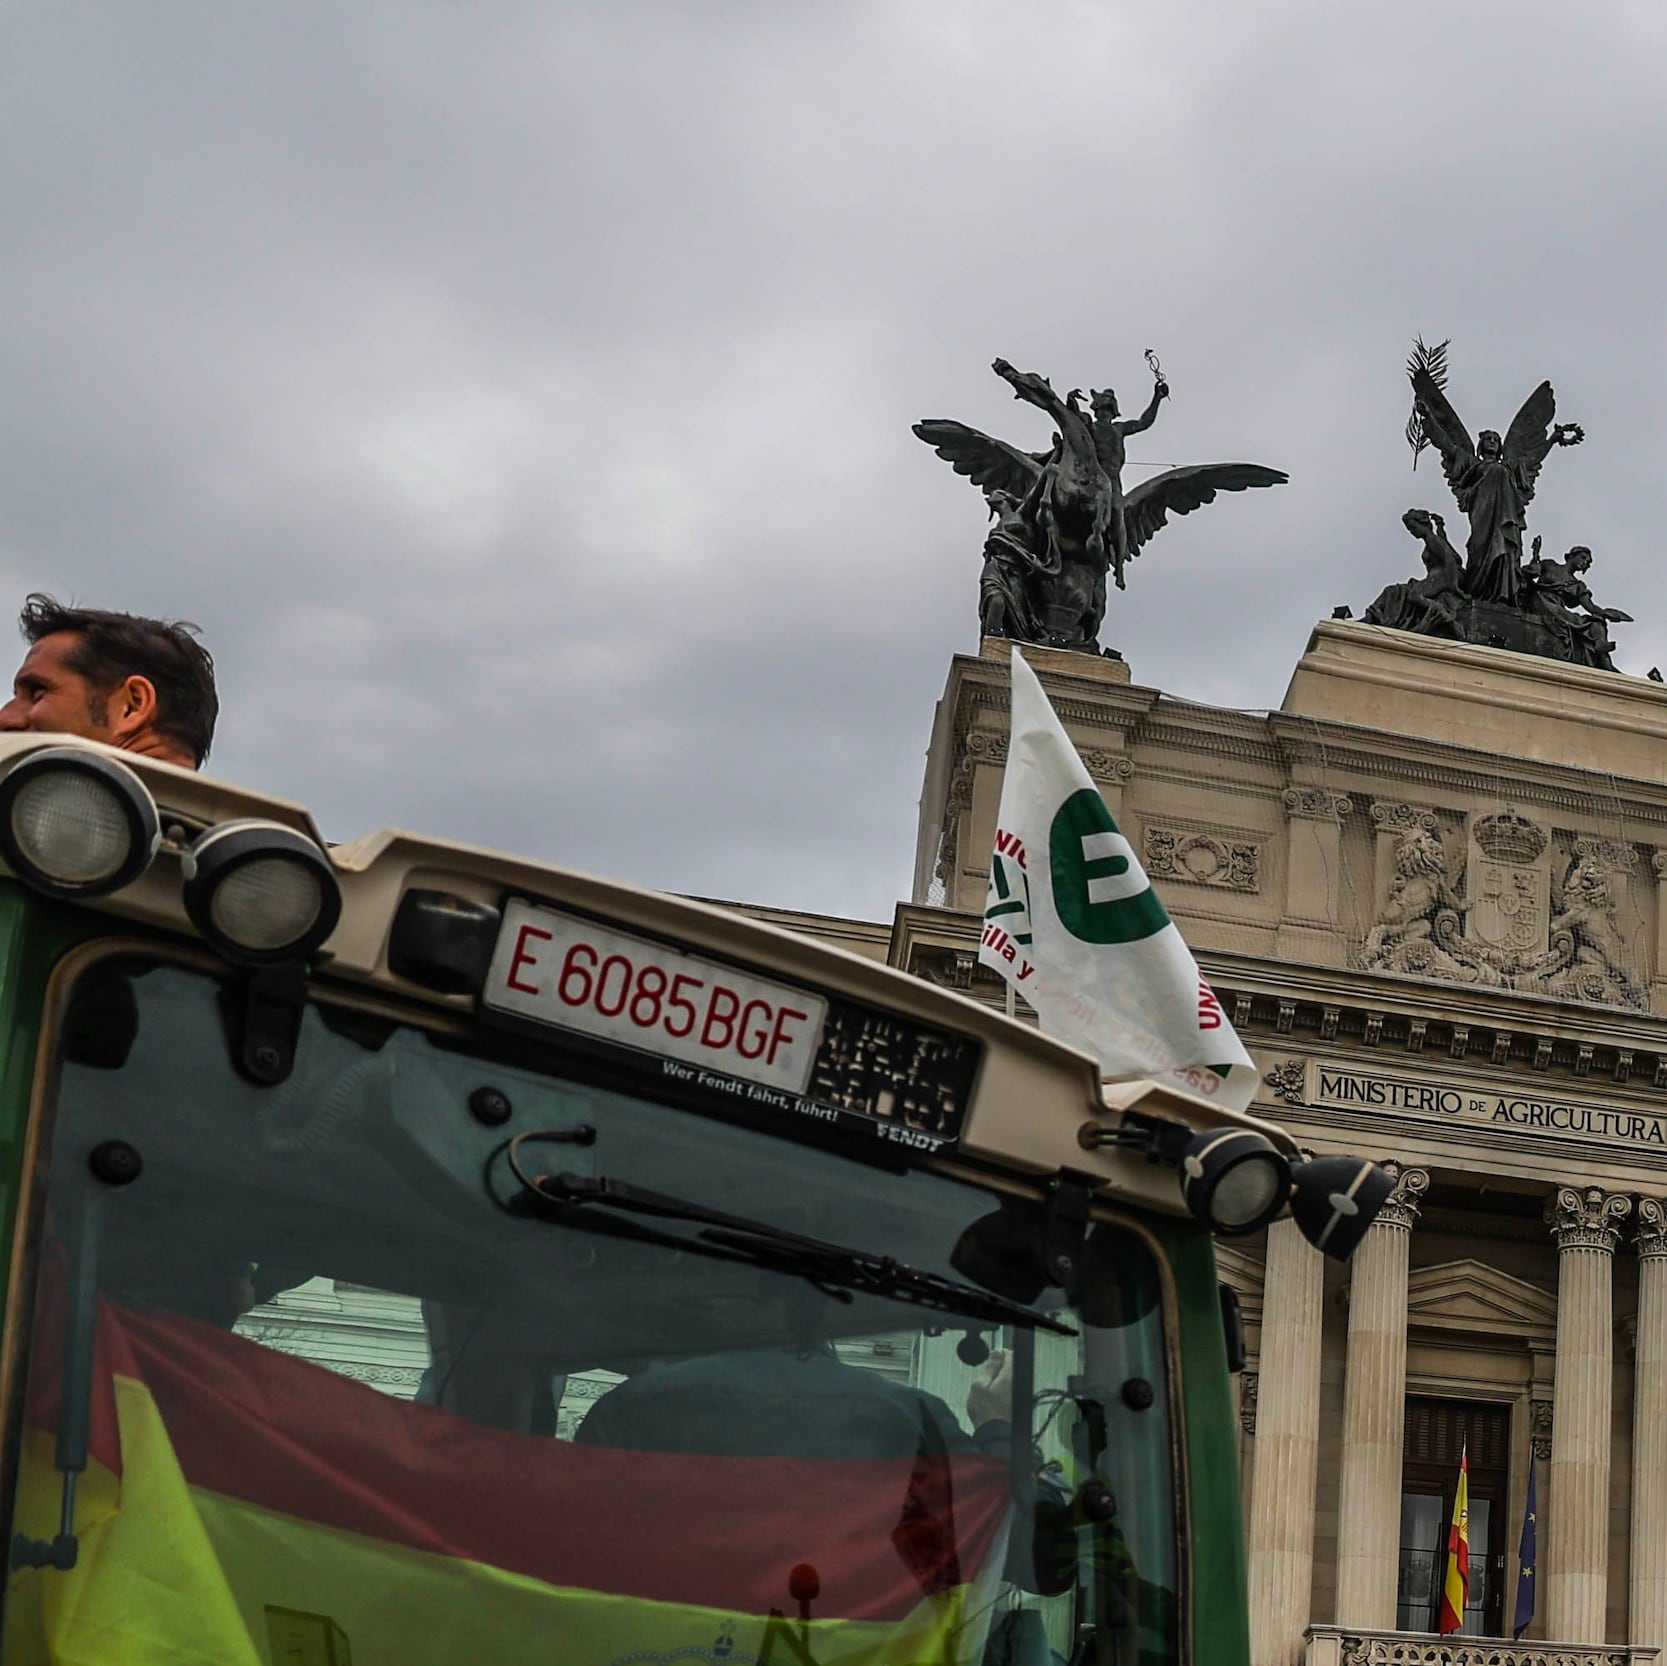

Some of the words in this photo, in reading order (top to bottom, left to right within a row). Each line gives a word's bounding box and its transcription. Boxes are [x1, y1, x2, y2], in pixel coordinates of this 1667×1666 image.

[507, 924, 553, 995] E
[662, 1061, 695, 1081] Wer
[697, 1071, 744, 1096] Fendt
[1319, 1073, 1462, 1115] MINISTERIO
[1491, 1098, 1665, 1144] AGRICULTURA
[877, 1122, 944, 1152] FENDT
